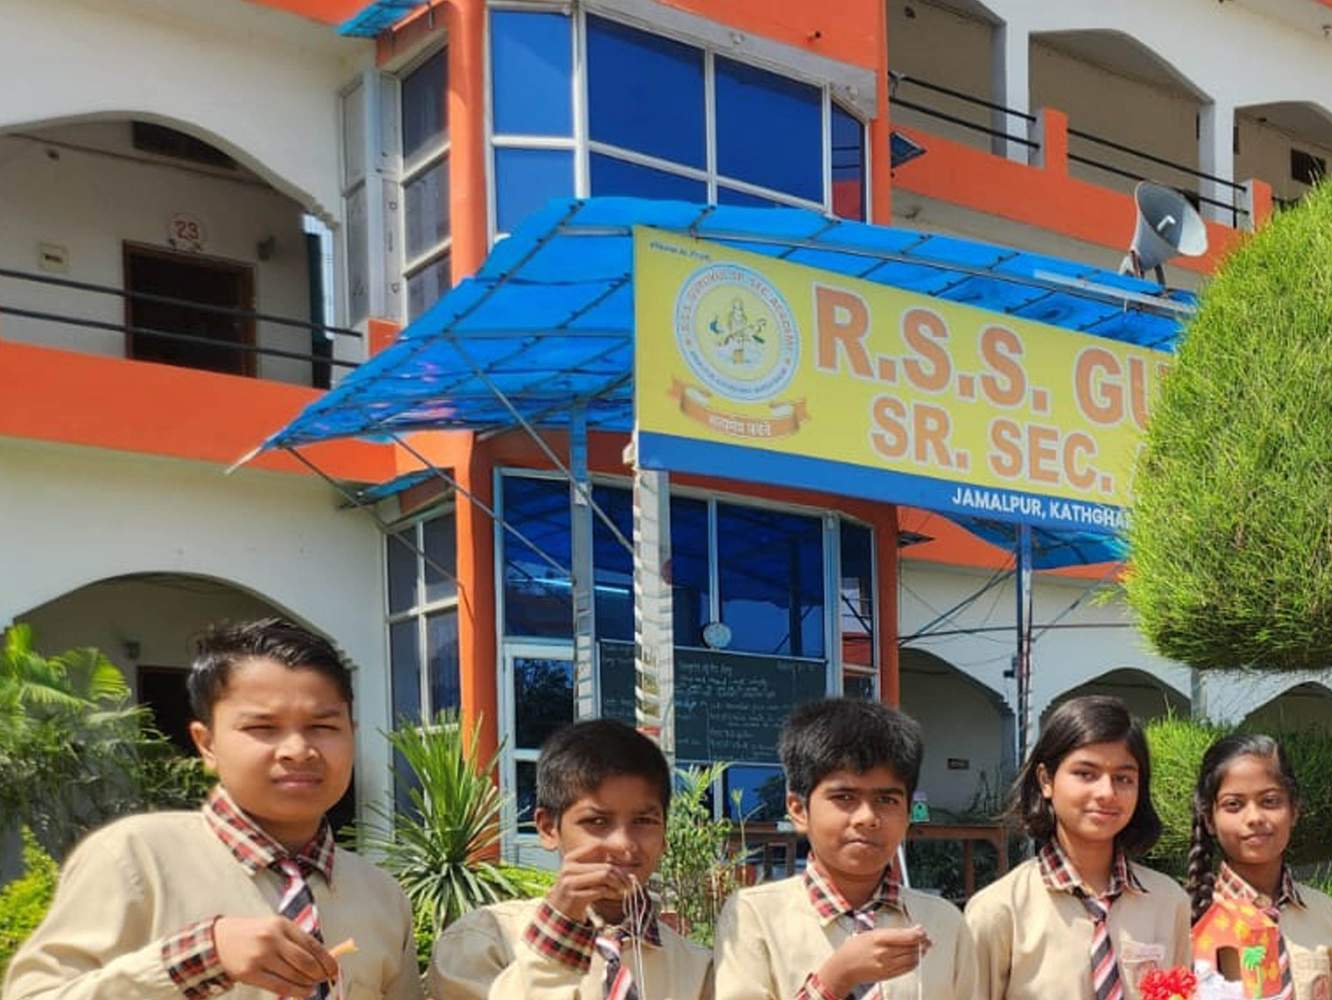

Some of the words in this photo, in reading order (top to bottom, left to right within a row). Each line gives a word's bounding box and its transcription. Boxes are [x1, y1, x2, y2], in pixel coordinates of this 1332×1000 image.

[174, 220, 200, 240] 23
[813, 283, 1048, 413] R.S.S.
[871, 397, 968, 469] SR.
[990, 418, 1112, 492] SEC.
[952, 487, 1047, 520] JAMALPUR,
